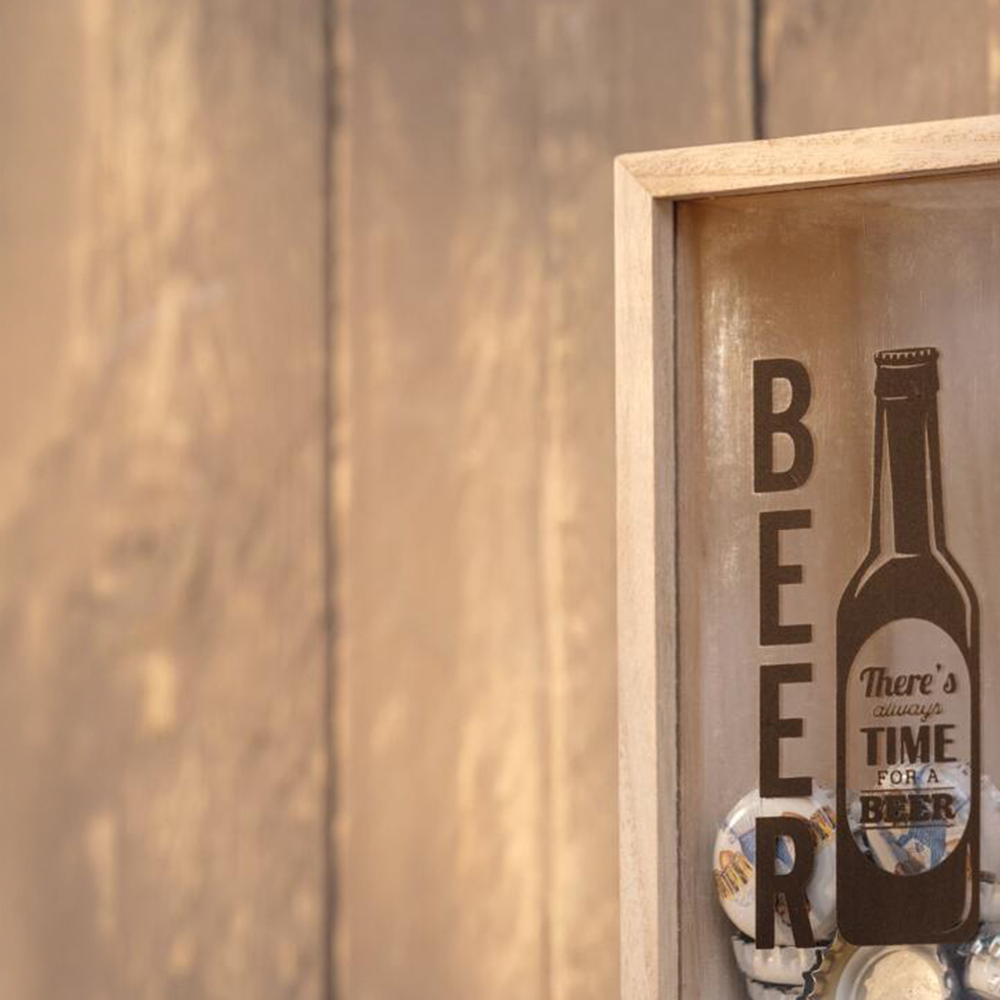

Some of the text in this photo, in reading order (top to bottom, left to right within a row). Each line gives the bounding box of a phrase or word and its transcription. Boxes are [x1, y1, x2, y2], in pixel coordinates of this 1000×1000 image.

[753, 358, 814, 949] BEER
[860, 663, 957, 698] There's
[873, 702, 943, 722] always
[860, 724, 957, 766] TIME
[877, 768, 940, 786] FOR A
[859, 793, 956, 824] BEER
